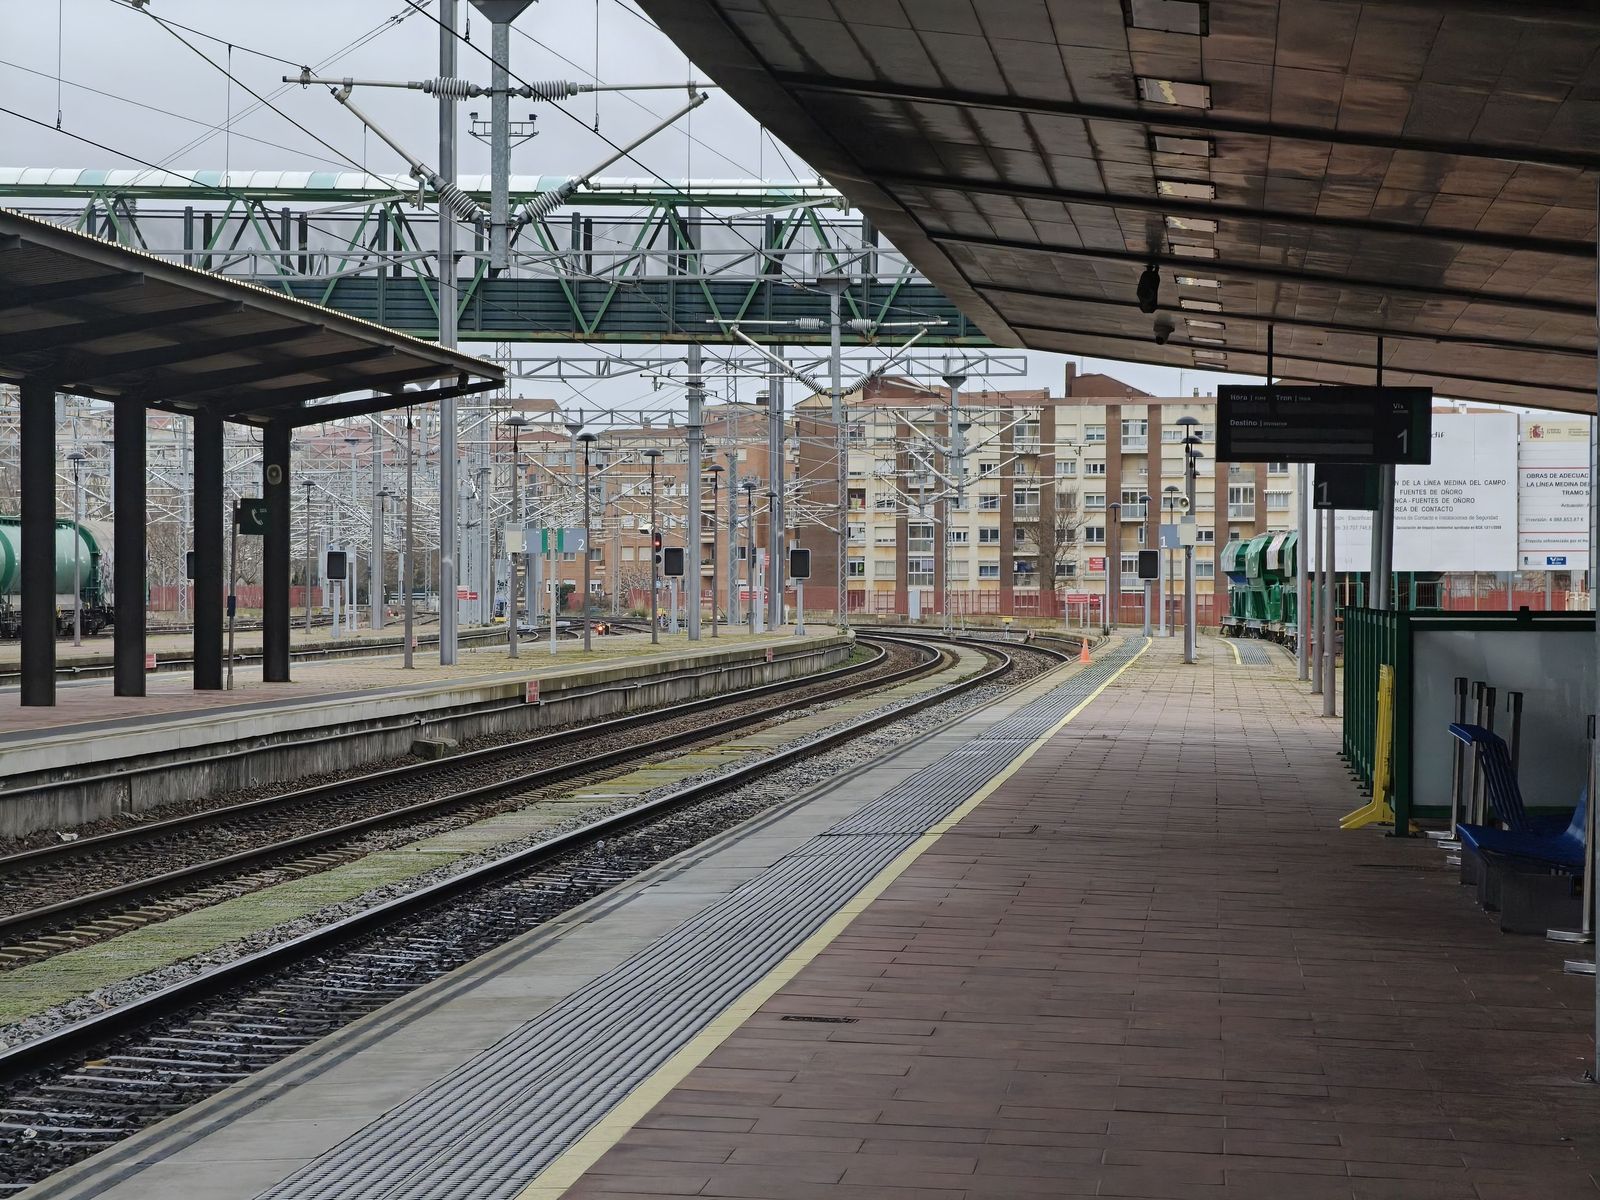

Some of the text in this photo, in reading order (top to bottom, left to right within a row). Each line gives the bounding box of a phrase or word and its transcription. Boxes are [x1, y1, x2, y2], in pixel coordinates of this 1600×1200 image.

[1397, 428, 1408, 454] 1
[1423, 477, 1441, 486] LÍNEA
[1535, 480, 1554, 488] LÍNEA
[1317, 481, 1332, 506] 1
[1440, 488, 1464, 496] OÑORO
[1452, 496, 1476, 504] OÑORO
[1410, 505, 1419, 513] DE
[1421, 505, 1454, 513] CONTACTO
[577, 539, 585, 551] 2
[1160, 536, 1167, 548] 1
